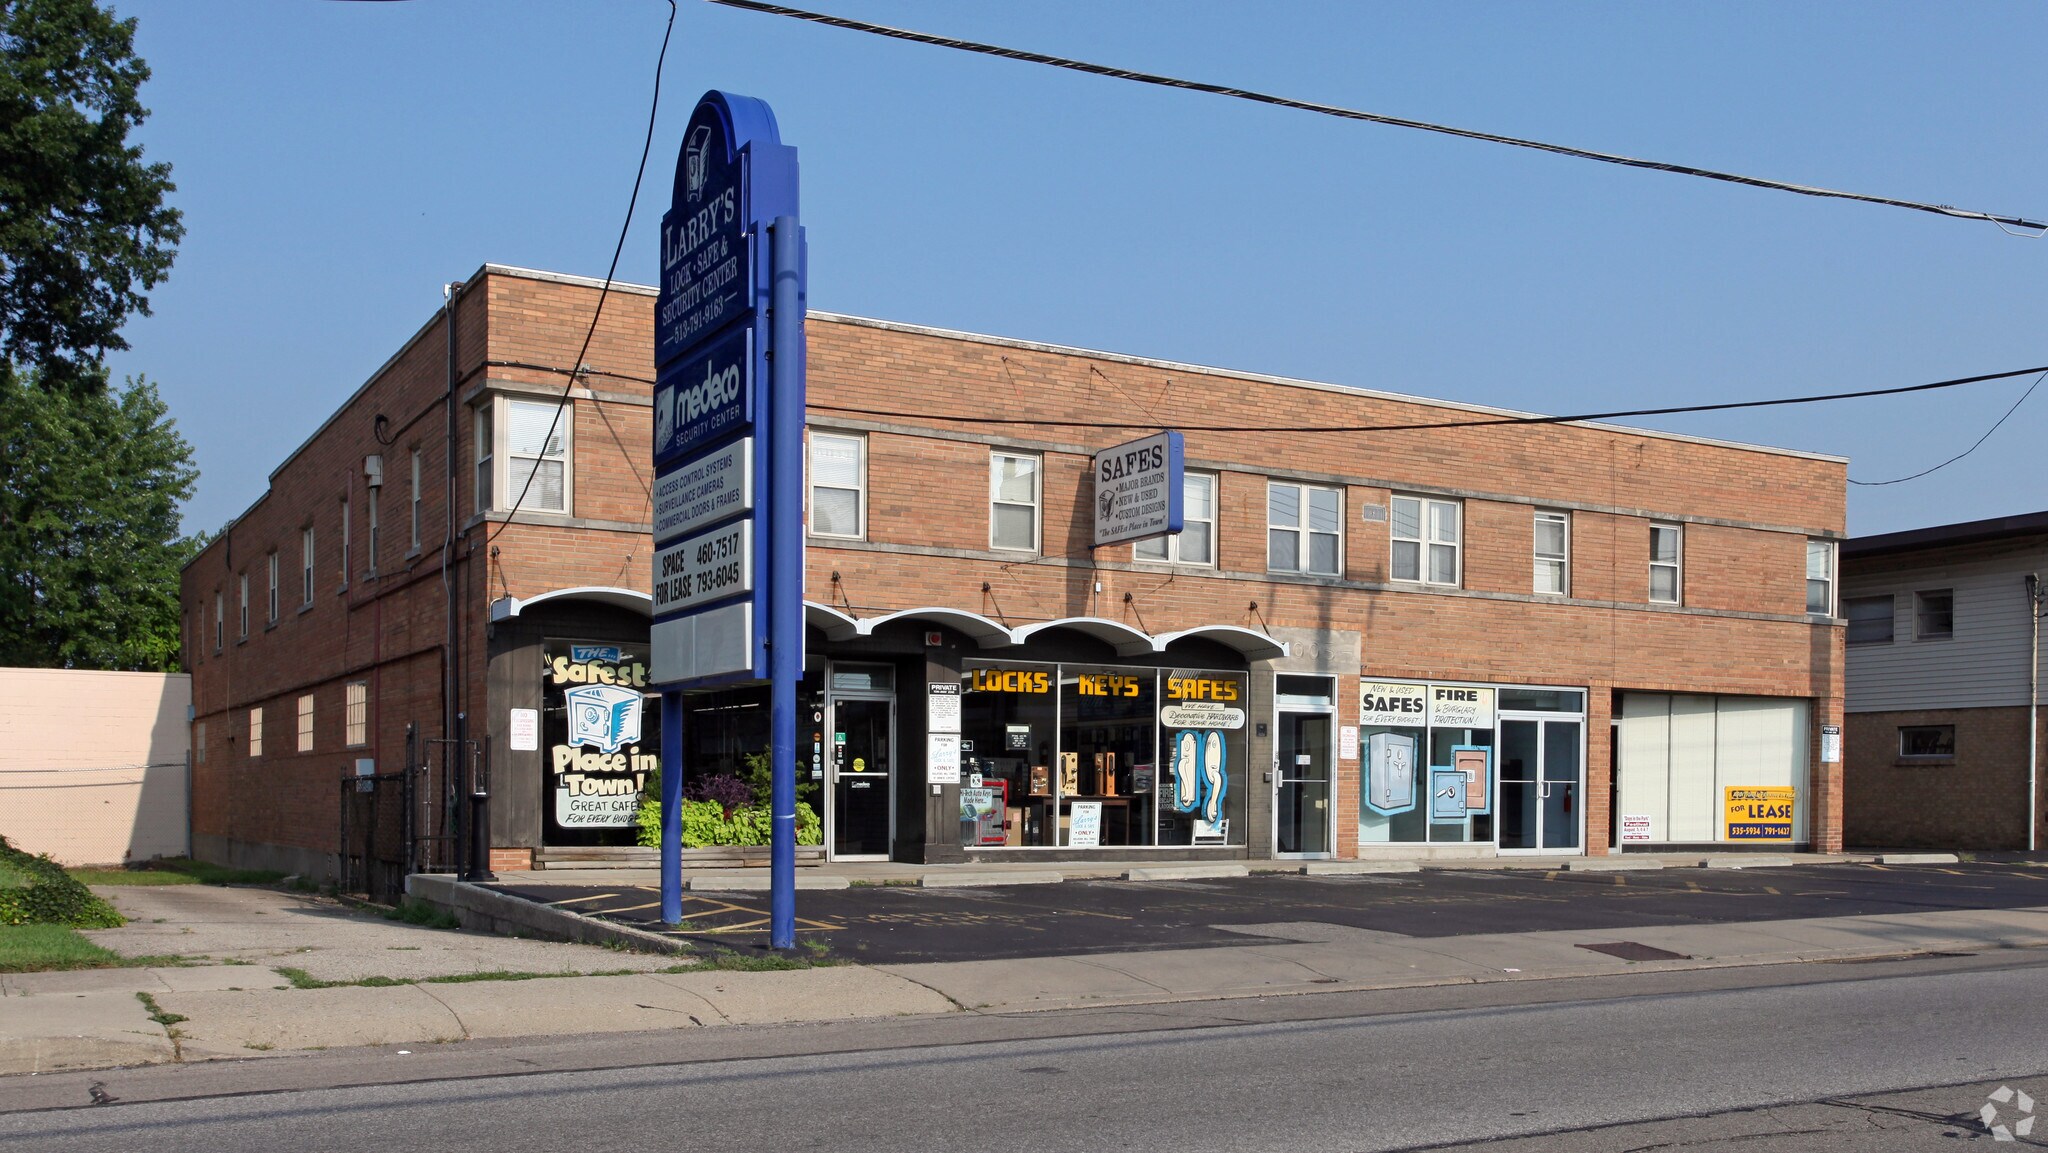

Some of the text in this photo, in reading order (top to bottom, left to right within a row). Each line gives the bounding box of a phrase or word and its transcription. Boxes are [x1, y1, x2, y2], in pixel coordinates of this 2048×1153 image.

[666, 185, 735, 271] LARRY'S
[670, 235, 728, 295] LOCK SAFE &
[662, 256, 738, 326] SECURITY CENTER
[674, 295, 724, 344] 513-791-9163
[676, 359, 740, 428] medeco
[676, 419, 709, 447] SECURITY
[711, 404, 740, 429] CENTER
[1101, 444, 1163, 483] SAFES
[659, 454, 733, 498] ACCESS CONTROL SYSTEMS
[1118, 472, 1165, 493] MAJOR BRANDS
[658, 475, 724, 515] SURVEILLANCE CAMERAS
[1118, 488, 1158, 507] NEW & USED
[659, 488, 740, 532] COMMERCIAL DOORS & FRAMES
[1118, 500, 1166, 520] CUSTOM DESIGNS
[1128, 520, 1141, 531] Place
[1142, 520, 1148, 528] in
[662, 532, 739, 578] SPACE 460-7517
[656, 561, 739, 606] FOR LEASE 793-6045
[971, 668, 1049, 693] LOCKS
[1078, 674, 1140, 697] KEYS
[1167, 678, 1238, 701] SAFES
[1369, 684, 1415, 695] NEW & USED
[1363, 693, 1424, 713] SAFES
[1435, 689, 1478, 702] FIRE
[1374, 714, 1396, 723] EVERY
[1396, 716, 1424, 725] BUDGET!
[1433, 715, 1479, 726] PROTECTION!
[1434, 704, 1477, 714] & BURGLARY
[552, 744, 658, 774] Place in
[564, 773, 645, 801] Town!
[570, 799, 608, 812] GREAT
[1730, 804, 1791, 818] FOR LEASE
[565, 813, 586, 823] FOR
[587, 814, 612, 824] EVERY
[1732, 827, 1761, 835] 535-5934
